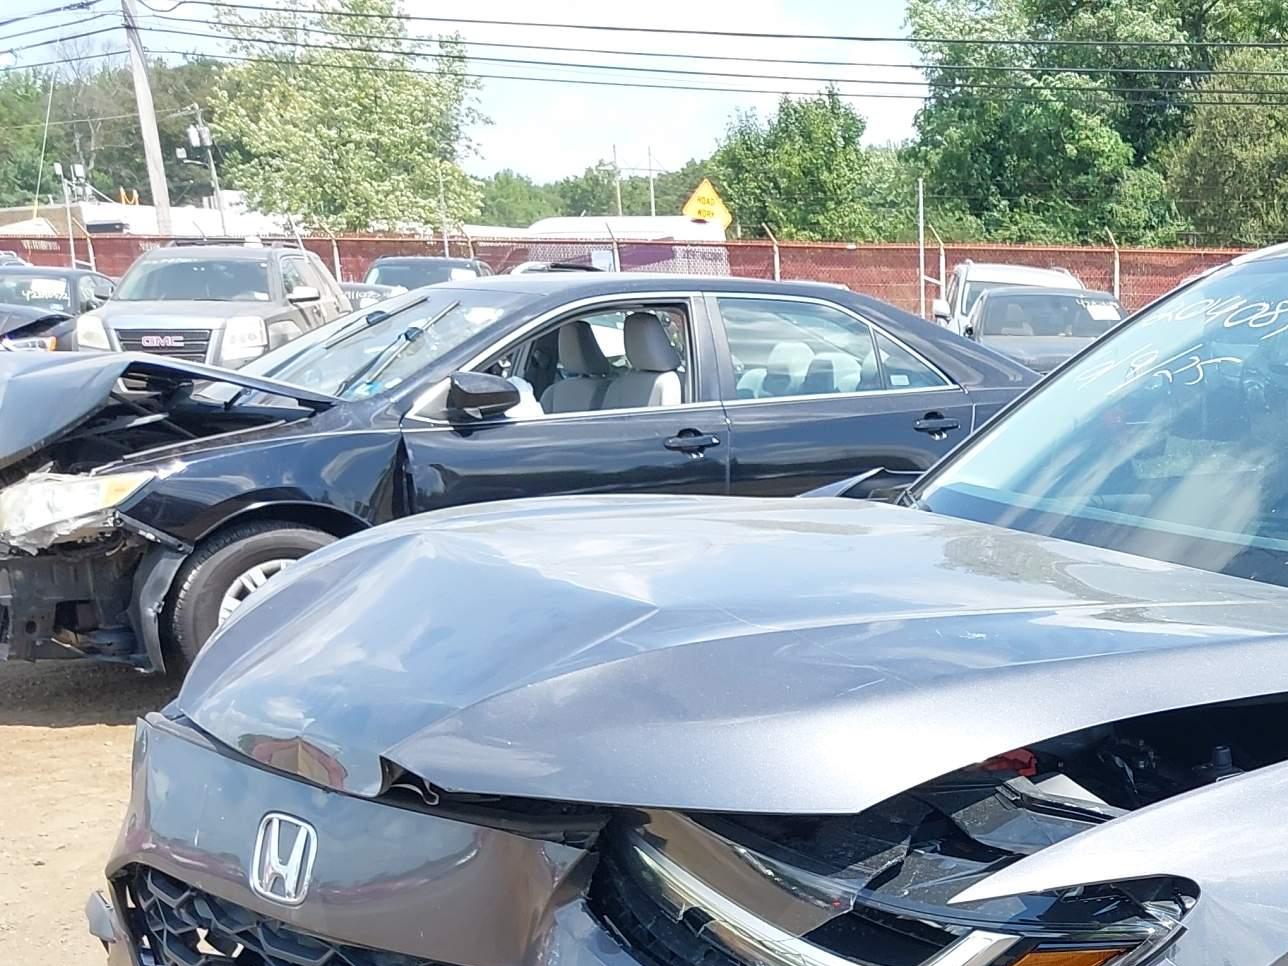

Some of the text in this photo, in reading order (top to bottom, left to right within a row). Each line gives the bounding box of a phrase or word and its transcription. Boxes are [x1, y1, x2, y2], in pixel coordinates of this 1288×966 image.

[698, 196, 715, 206] ROAD
[698, 209, 715, 218] WORK
[141, 335, 184, 348] GMC
